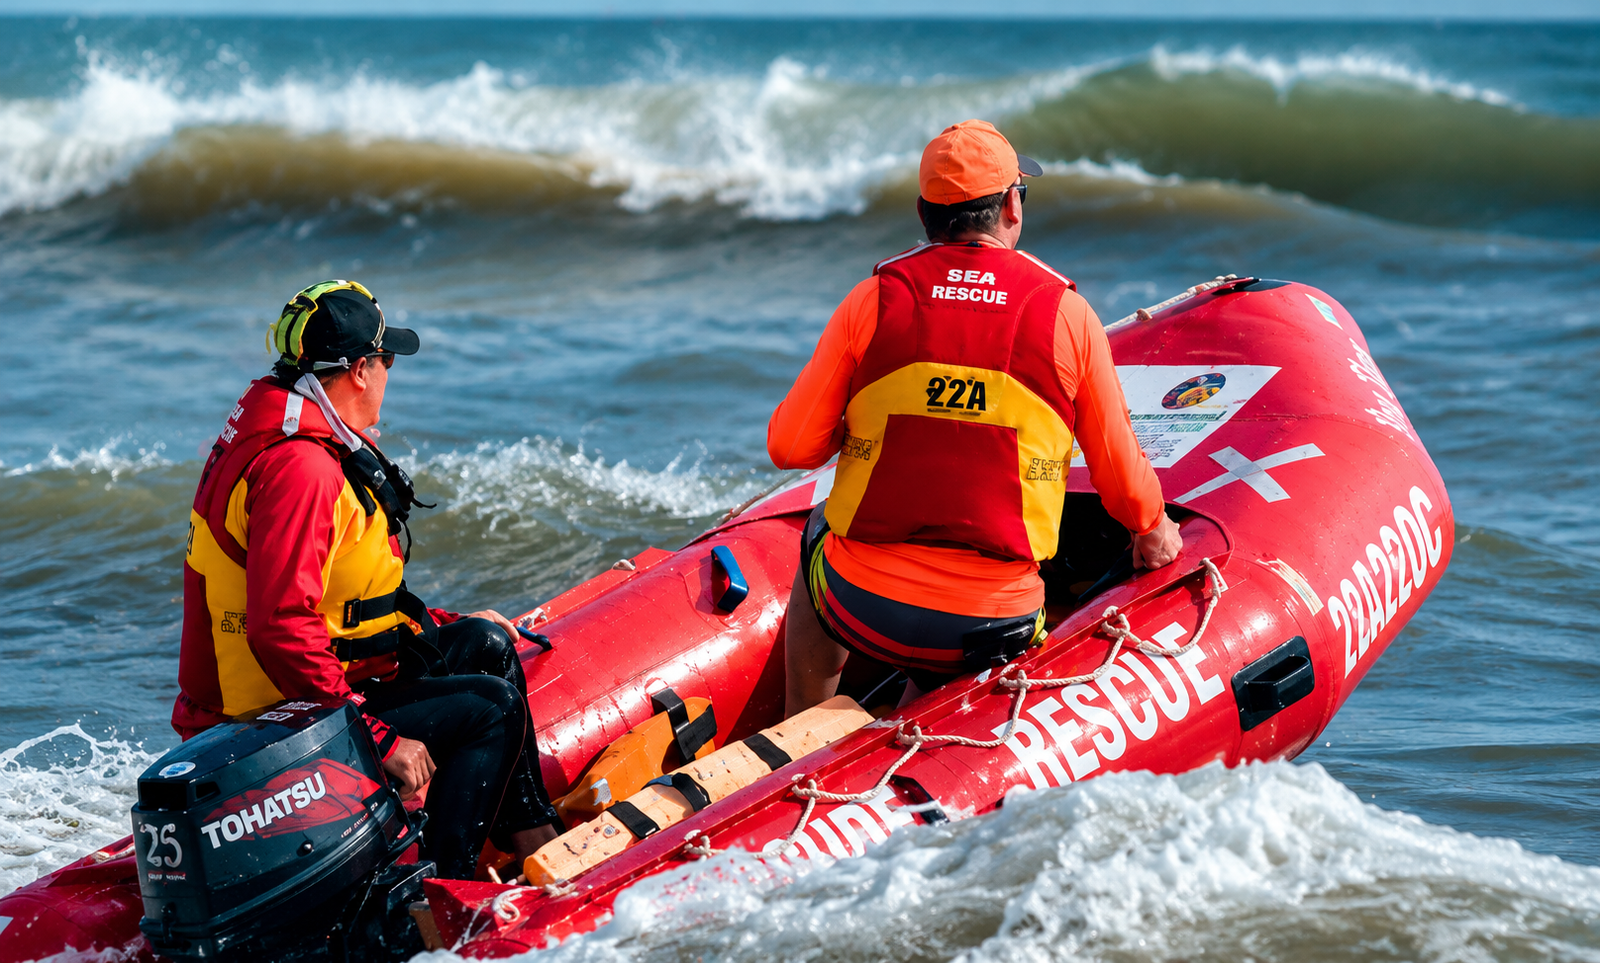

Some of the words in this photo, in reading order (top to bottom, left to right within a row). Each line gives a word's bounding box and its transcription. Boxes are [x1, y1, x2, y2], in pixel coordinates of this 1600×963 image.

[931, 285, 1008, 305] RESCUE
[946, 269, 996, 285] SEA
[926, 376, 986, 411] 22A
[1327, 485, 1443, 680] 22A220C
[990, 621, 1226, 790] RESCUE
[200, 771, 327, 850] TOHATSU
[139, 823, 183, 868] 25
